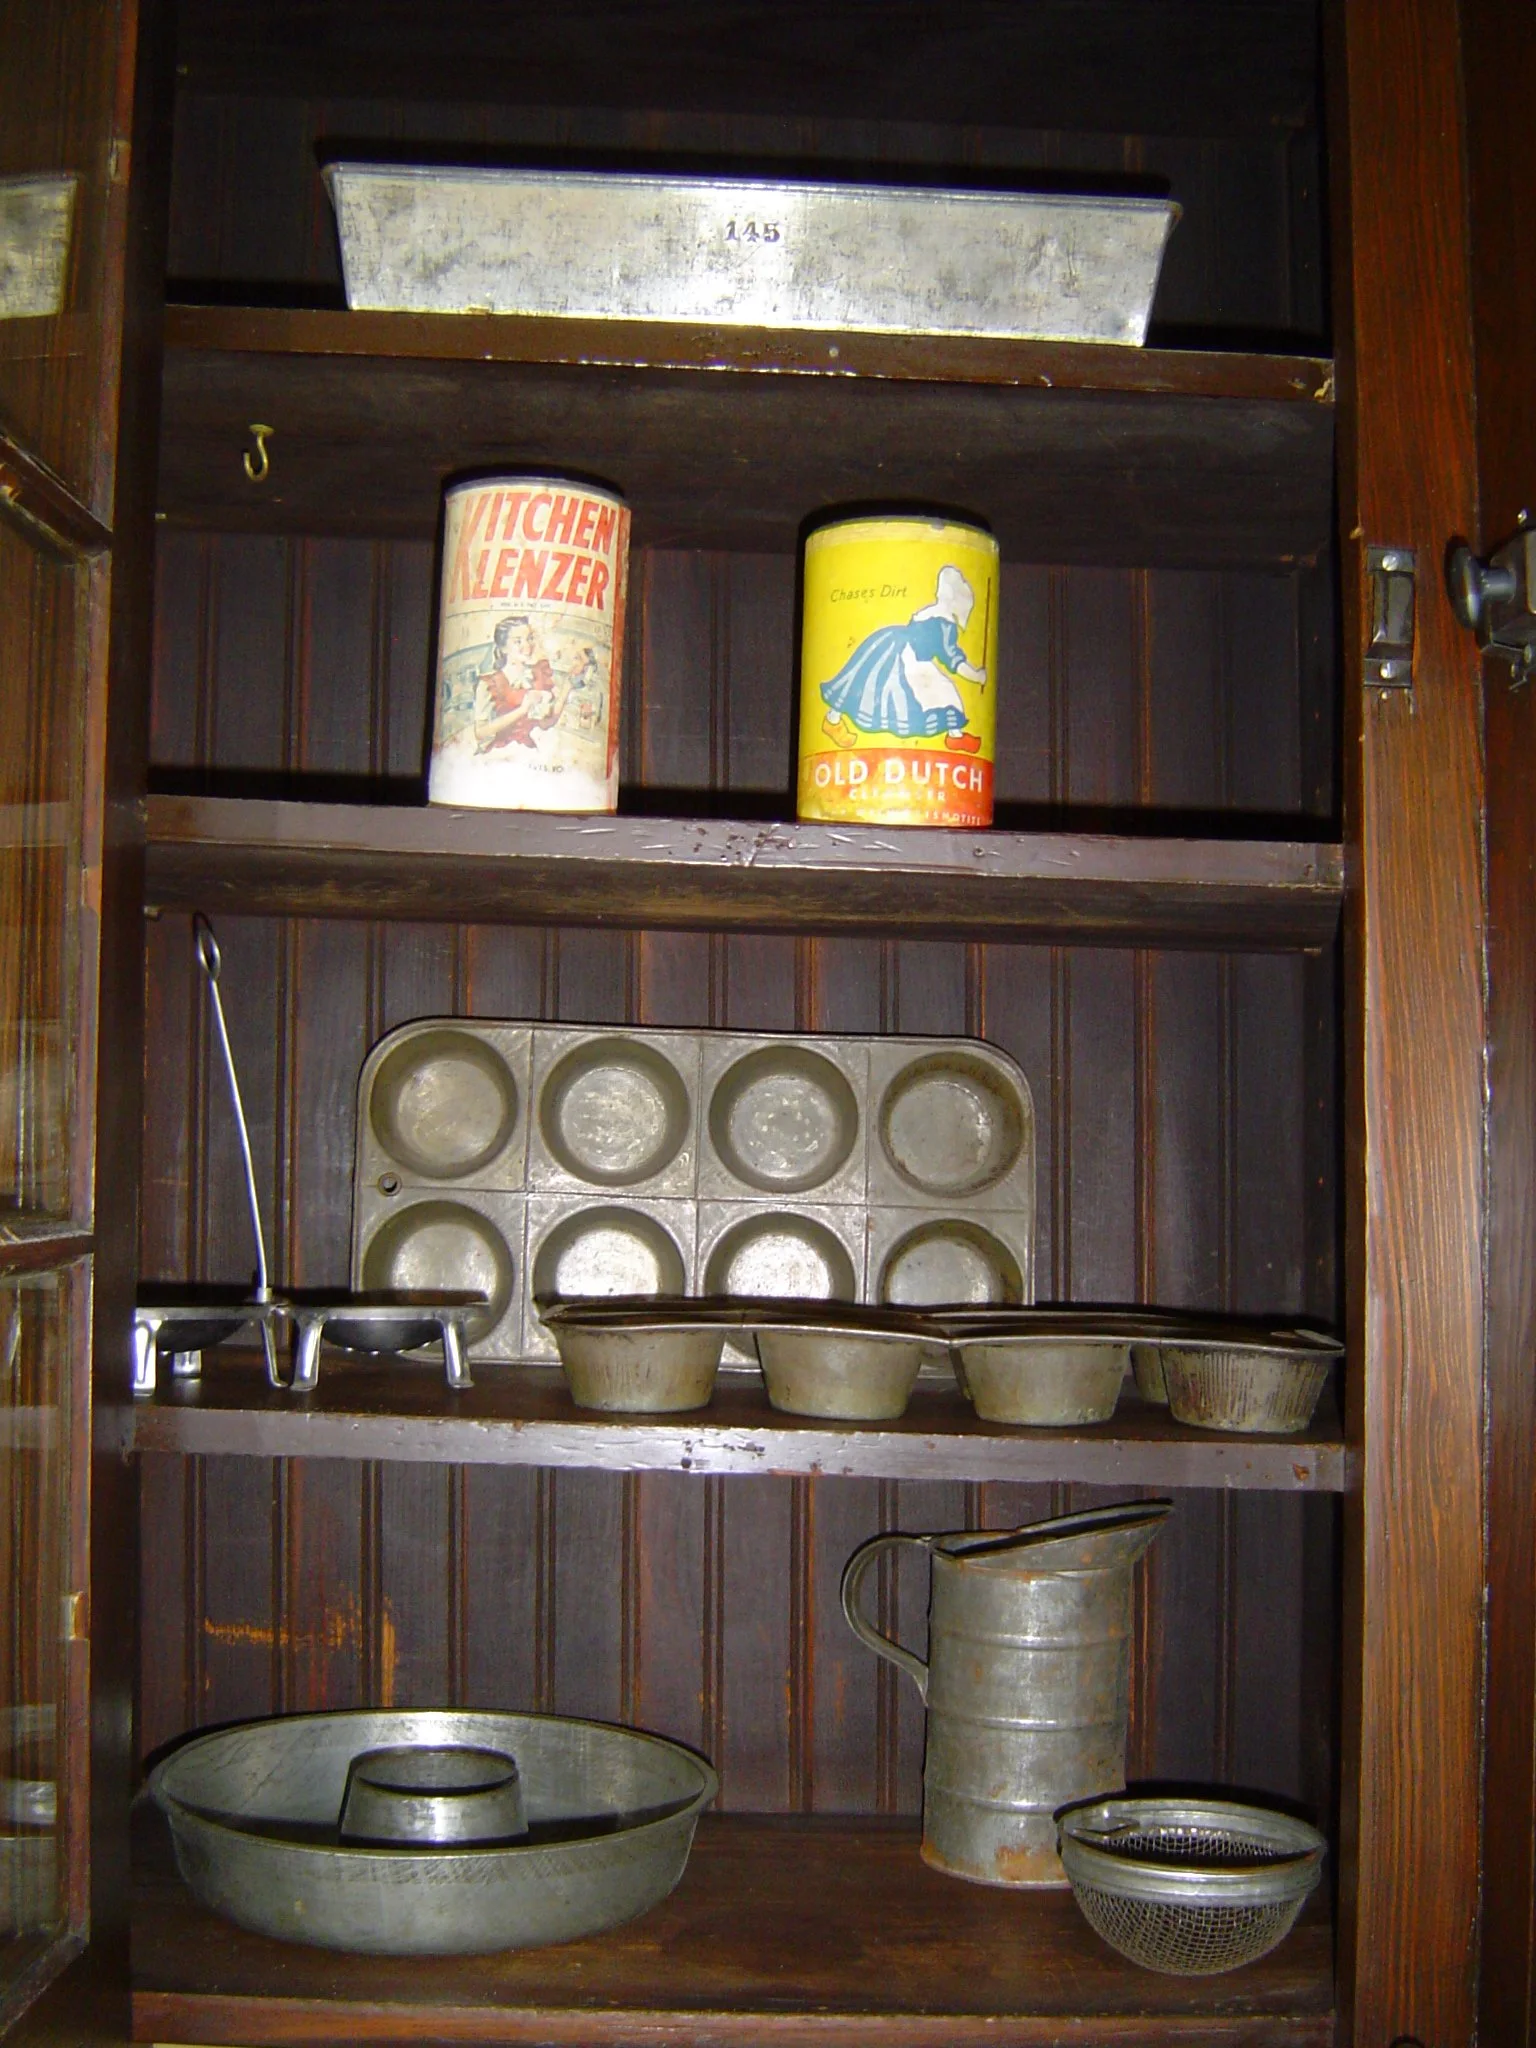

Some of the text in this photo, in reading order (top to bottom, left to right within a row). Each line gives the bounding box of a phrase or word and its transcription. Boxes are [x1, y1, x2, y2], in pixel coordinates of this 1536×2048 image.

[724, 220, 781, 242] 145
[457, 492, 616, 556] KITCHEN
[830, 583, 907, 603] Chases Dirt
[814, 757, 983, 793] OLD DUTCH
